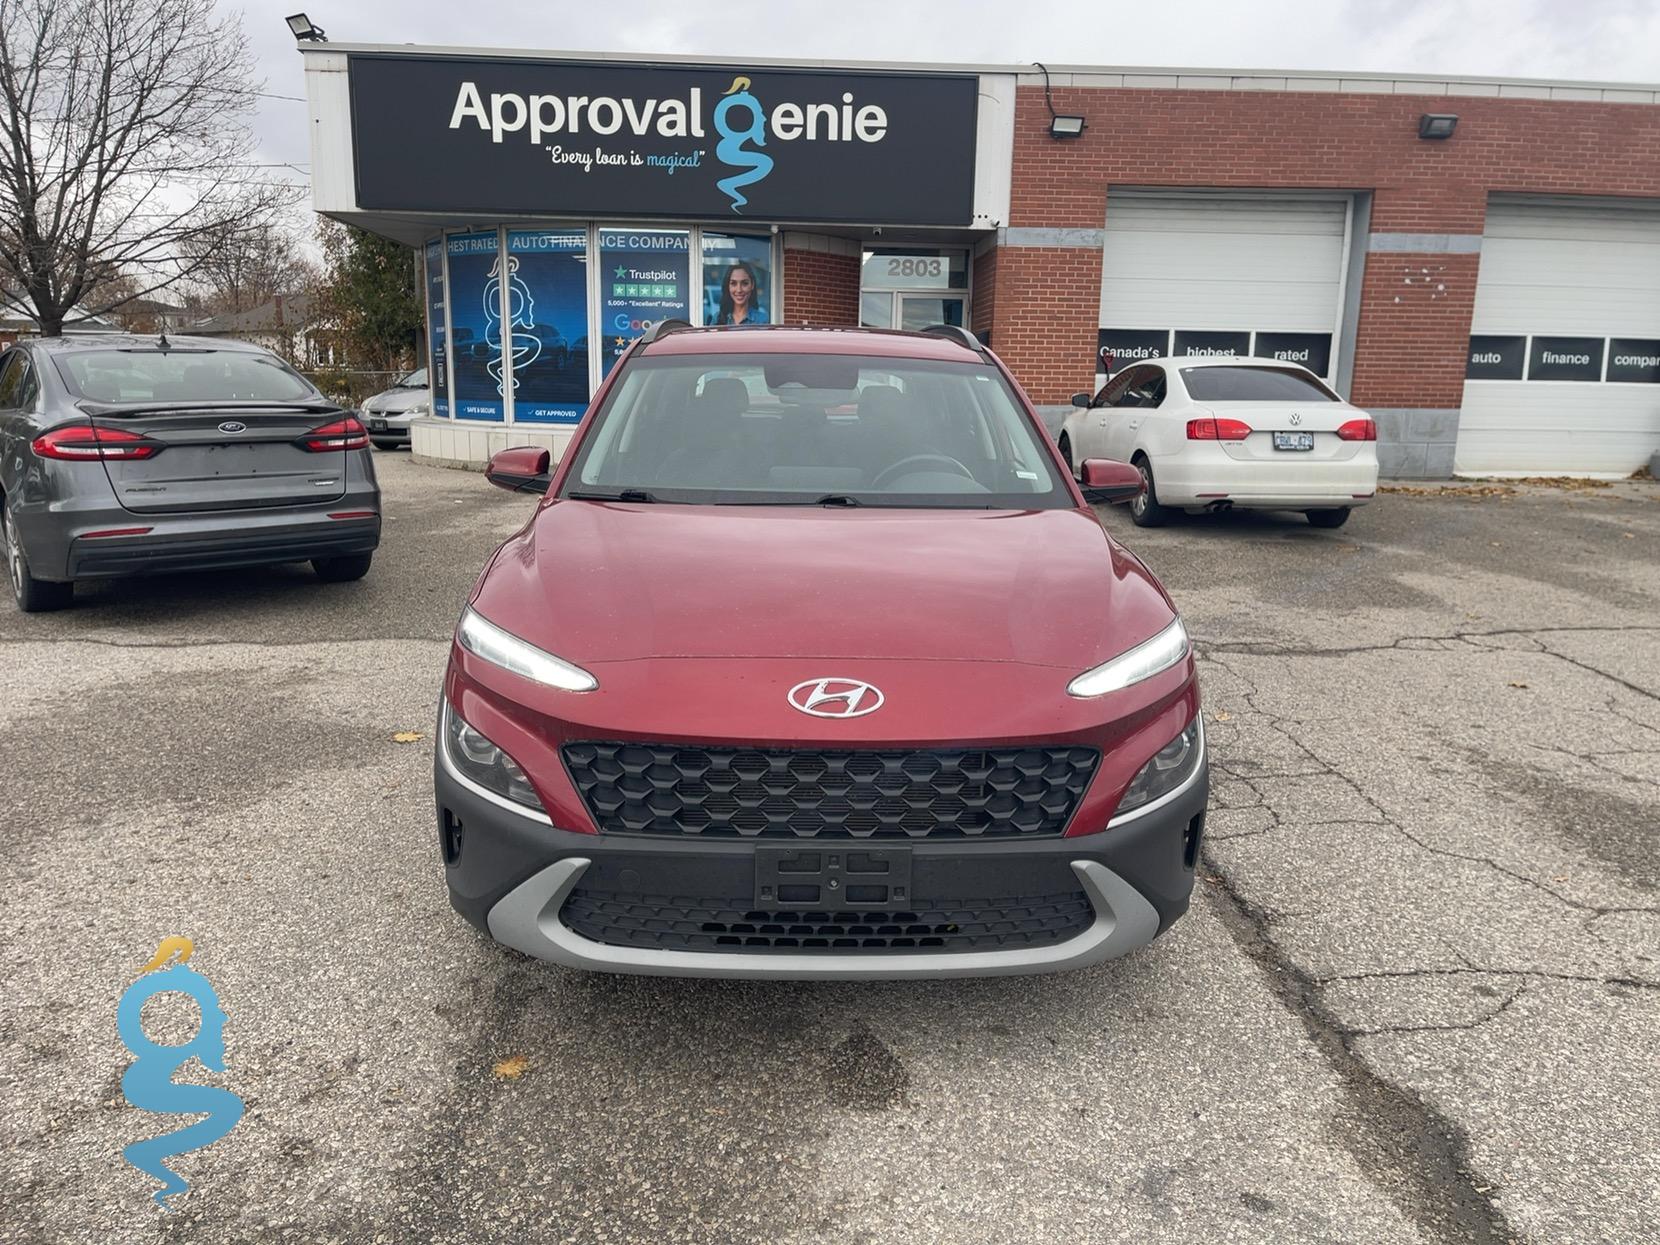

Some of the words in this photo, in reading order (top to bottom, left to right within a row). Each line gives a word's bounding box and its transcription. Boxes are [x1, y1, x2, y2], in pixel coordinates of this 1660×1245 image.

[449, 82, 705, 144] Approval
[545, 145, 593, 173] “Every
[596, 147, 628, 166] loan
[630, 150, 644, 166] is
[647, 150, 706, 175] magical”
[512, 236, 548, 249] AUTO
[887, 258, 942, 277] 2803
[629, 269, 676, 282] Trustpilot
[1100, 346, 1160, 358] Canada's
[1274, 349, 1309, 361] rated
[1472, 352, 1502, 364] auto
[1542, 351, 1590, 365] finance
